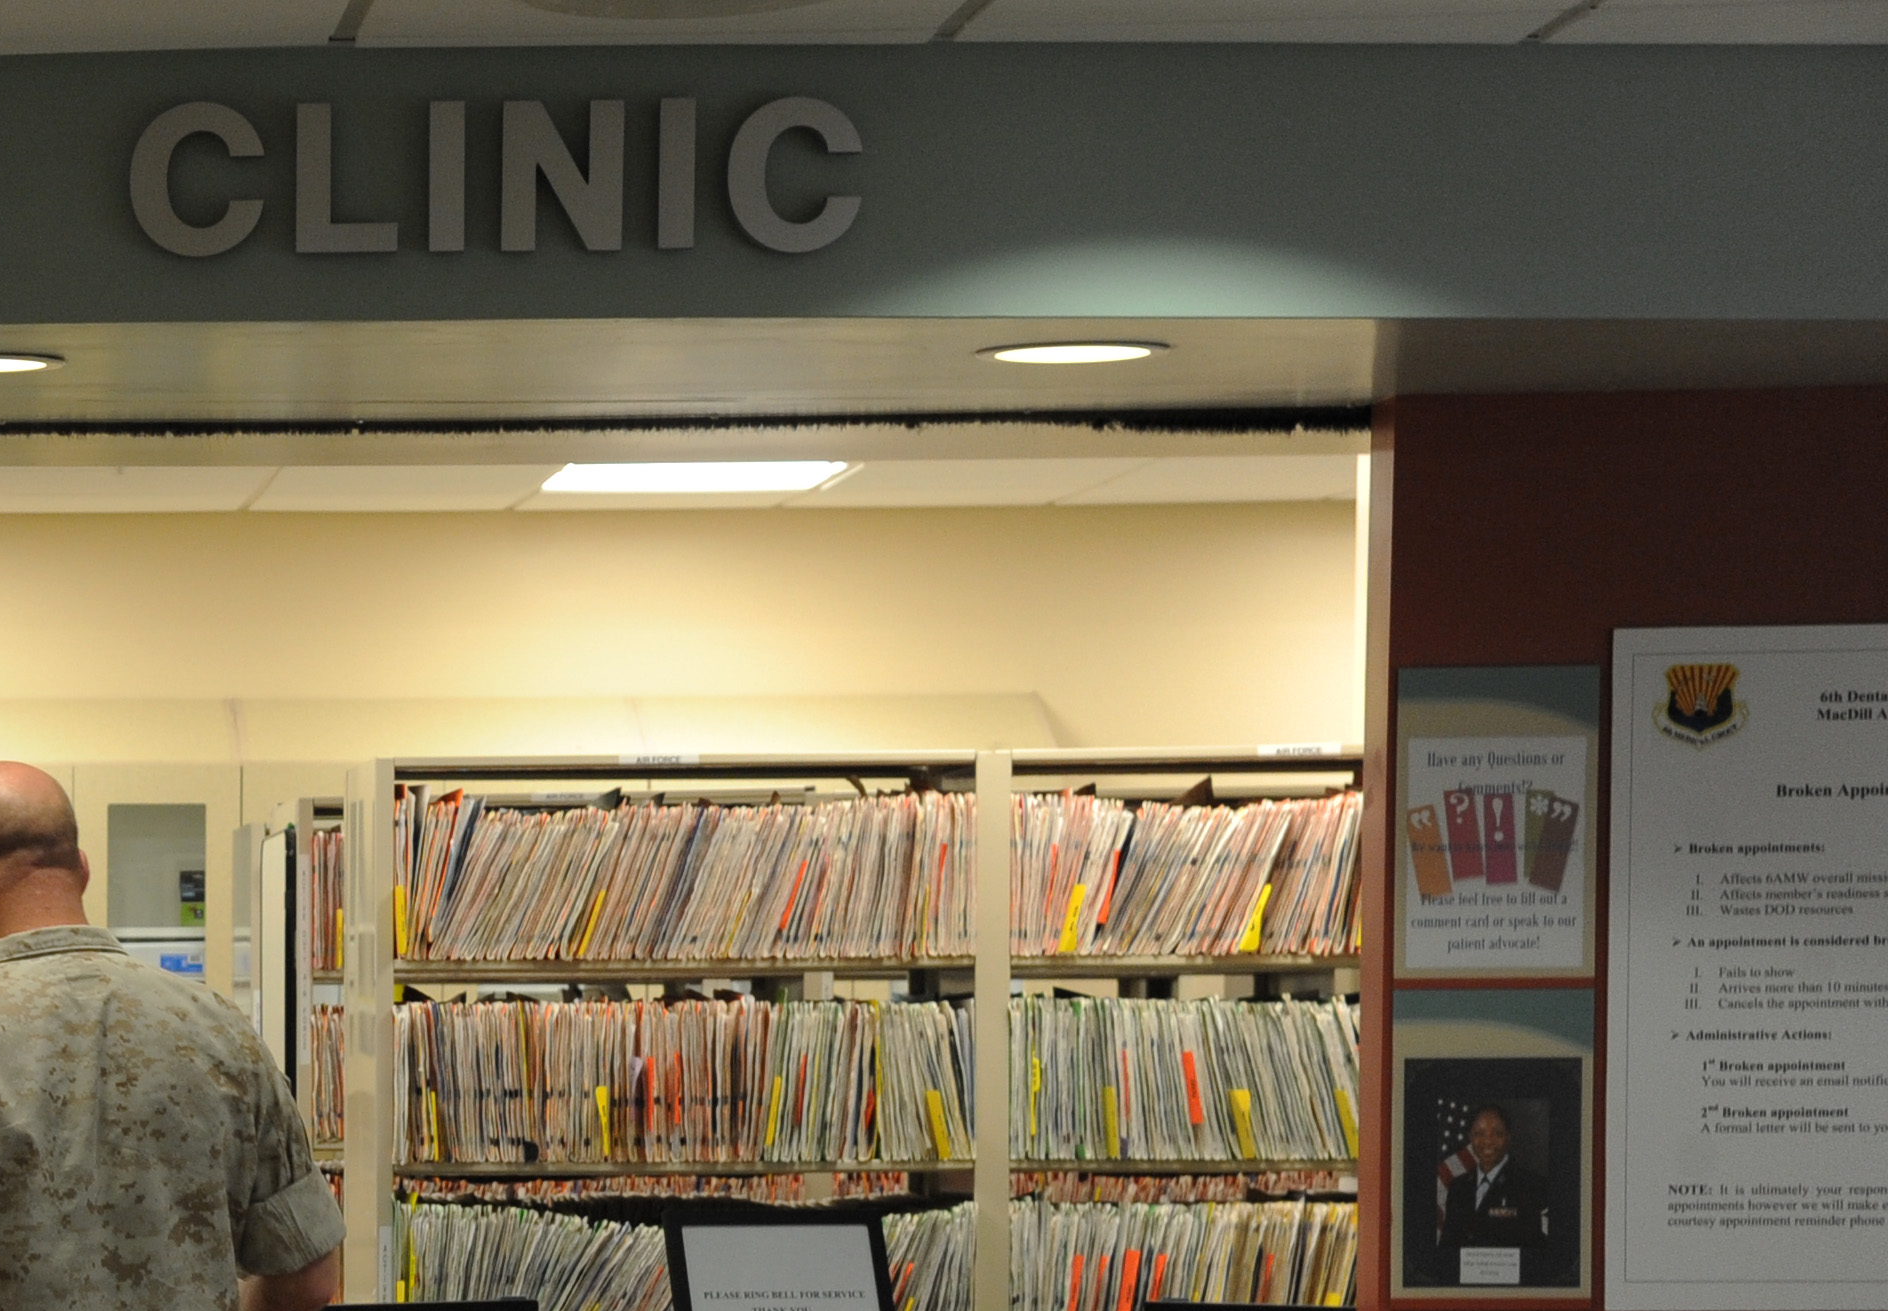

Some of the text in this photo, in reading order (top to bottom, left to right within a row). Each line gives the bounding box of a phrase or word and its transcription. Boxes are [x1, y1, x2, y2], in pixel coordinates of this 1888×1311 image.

[130, 96, 863, 256] CLINIC
[1820, 691, 1842, 702] 6th
[1818, 708, 1872, 720] MacDill
[1428, 752, 1564, 770] Have any Questions or
[1777, 784, 1832, 797] Broken
[1689, 843, 1825, 856] Broken appointments:
[1721, 873, 1762, 884] Affects
[1812, 872, 1853, 884] overall
[1421, 894, 1455, 906] Please
[1459, 892, 1478, 905] feel
[1482, 892, 1503, 905] free
[1506, 893, 1517, 904] to
[1539, 893, 1557, 905] out
[1561, 895, 1567, 904] a
[1720, 889, 1762, 900] Affects
[1826, 887, 1880, 899] readiness
[1720, 905, 1761, 916] Wastes
[1765, 904, 1795, 915] DOD
[1799, 906, 1853, 915] resources
[1411, 913, 1576, 931] comment card or speak to our
[1448, 935, 1540, 953] patient advocate!
[1688, 938, 1705, 947] An
[1709, 937, 1786, 949] appointment
[1790, 936, 1799, 946] is
[1804, 935, 1869, 946] considered
[1719, 967, 1746, 978] Fails
[1750, 968, 1761, 977] to
[1765, 966, 1794, 977] show
[1719, 983, 1761, 994] Arrives
[1765, 985, 1794, 993] more
[1798, 981, 1822, 992] than
[1828, 981, 1841, 992] 10
[1718, 997, 1763, 1009] Cancels
[1767, 998, 1784, 1009] the
[1788, 999, 1860, 1011] appointment
[1687, 1030, 1832, 1040] Administrative Actions:
[1720, 1061, 1763, 1071] Broken
[1768, 1061, 1845, 1073] appointment
[1702, 1076, 1725, 1087] You
[1730, 1076, 1751, 1086] will
[1755, 1077, 1796, 1087] receive
[1800, 1078, 1813, 1086] an
[1817, 1075, 1849, 1086] email
[1723, 1107, 1766, 1118] Broken
[1771, 1107, 1848, 1120] appointment
[1701, 1123, 1710, 1133] A
[1715, 1122, 1752, 1133] formal
[1756, 1122, 1785, 1133] letter
[1789, 1122, 1811, 1133] will
[1815, 1122, 1828, 1133] be
[1832, 1123, 1855, 1133] sent
[1859, 1123, 1870, 1132] to
[1669, 1185, 1711, 1195] NOTE:
[1720, 1184, 1728, 1195] It
[1735, 1185, 1744, 1195] is
[1751, 1183, 1809, 1198] ultimately
[1816, 1187, 1842, 1197] your
[1668, 1201, 1744, 1213] appointments
[1748, 1199, 1797, 1211] however
[1801, 1202, 1817, 1210] we
[1822, 1199, 1843, 1210] will
[1847, 1200, 1878, 1210] make
[1667, 1215, 1885, 1229] courtesy appointment reminder phone
[704, 1290, 865, 1300] PLEASE RING BELL FOR SERVICE
